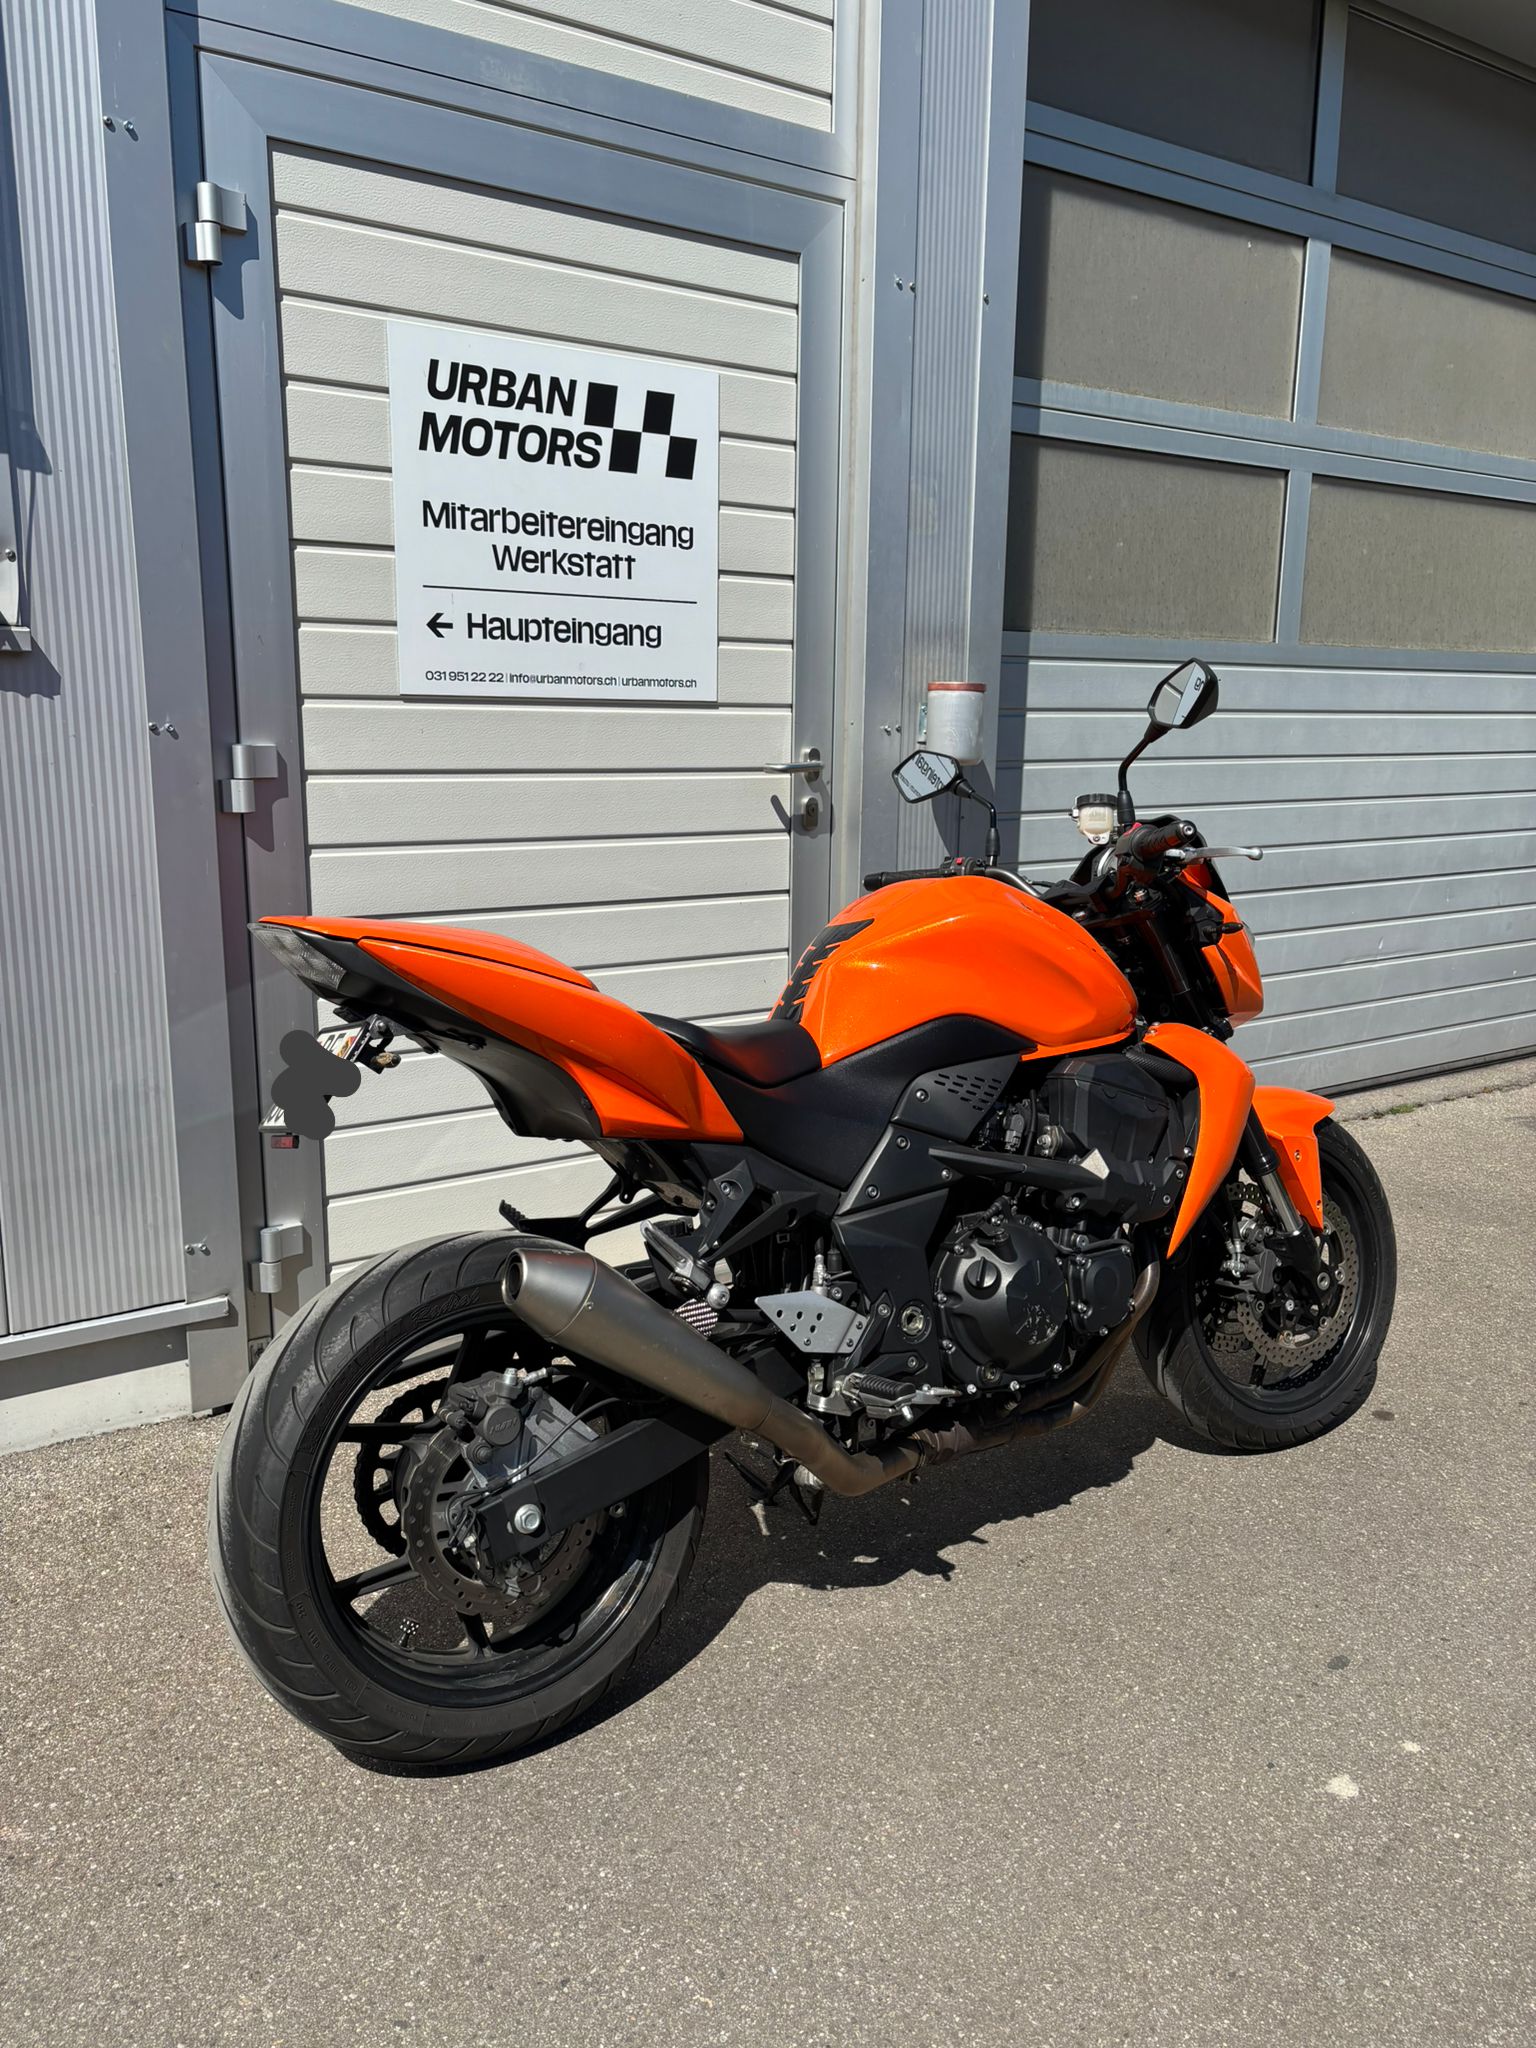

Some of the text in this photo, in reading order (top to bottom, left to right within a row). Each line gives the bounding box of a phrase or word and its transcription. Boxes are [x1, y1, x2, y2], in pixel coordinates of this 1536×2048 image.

[427, 358, 578, 417] URBAN
[418, 411, 603, 469] MOTORS
[422, 500, 694, 551] Mitarbeitereingang
[491, 544, 637, 580] Werkstatt
[466, 612, 662, 649] Haupteingang
[425, 670, 447, 681] 031
[448, 671, 469, 682] 951
[470, 672, 487, 683] 22
[488, 672, 505, 683] 22
[621, 676, 698, 688] urbanmotors.ch
